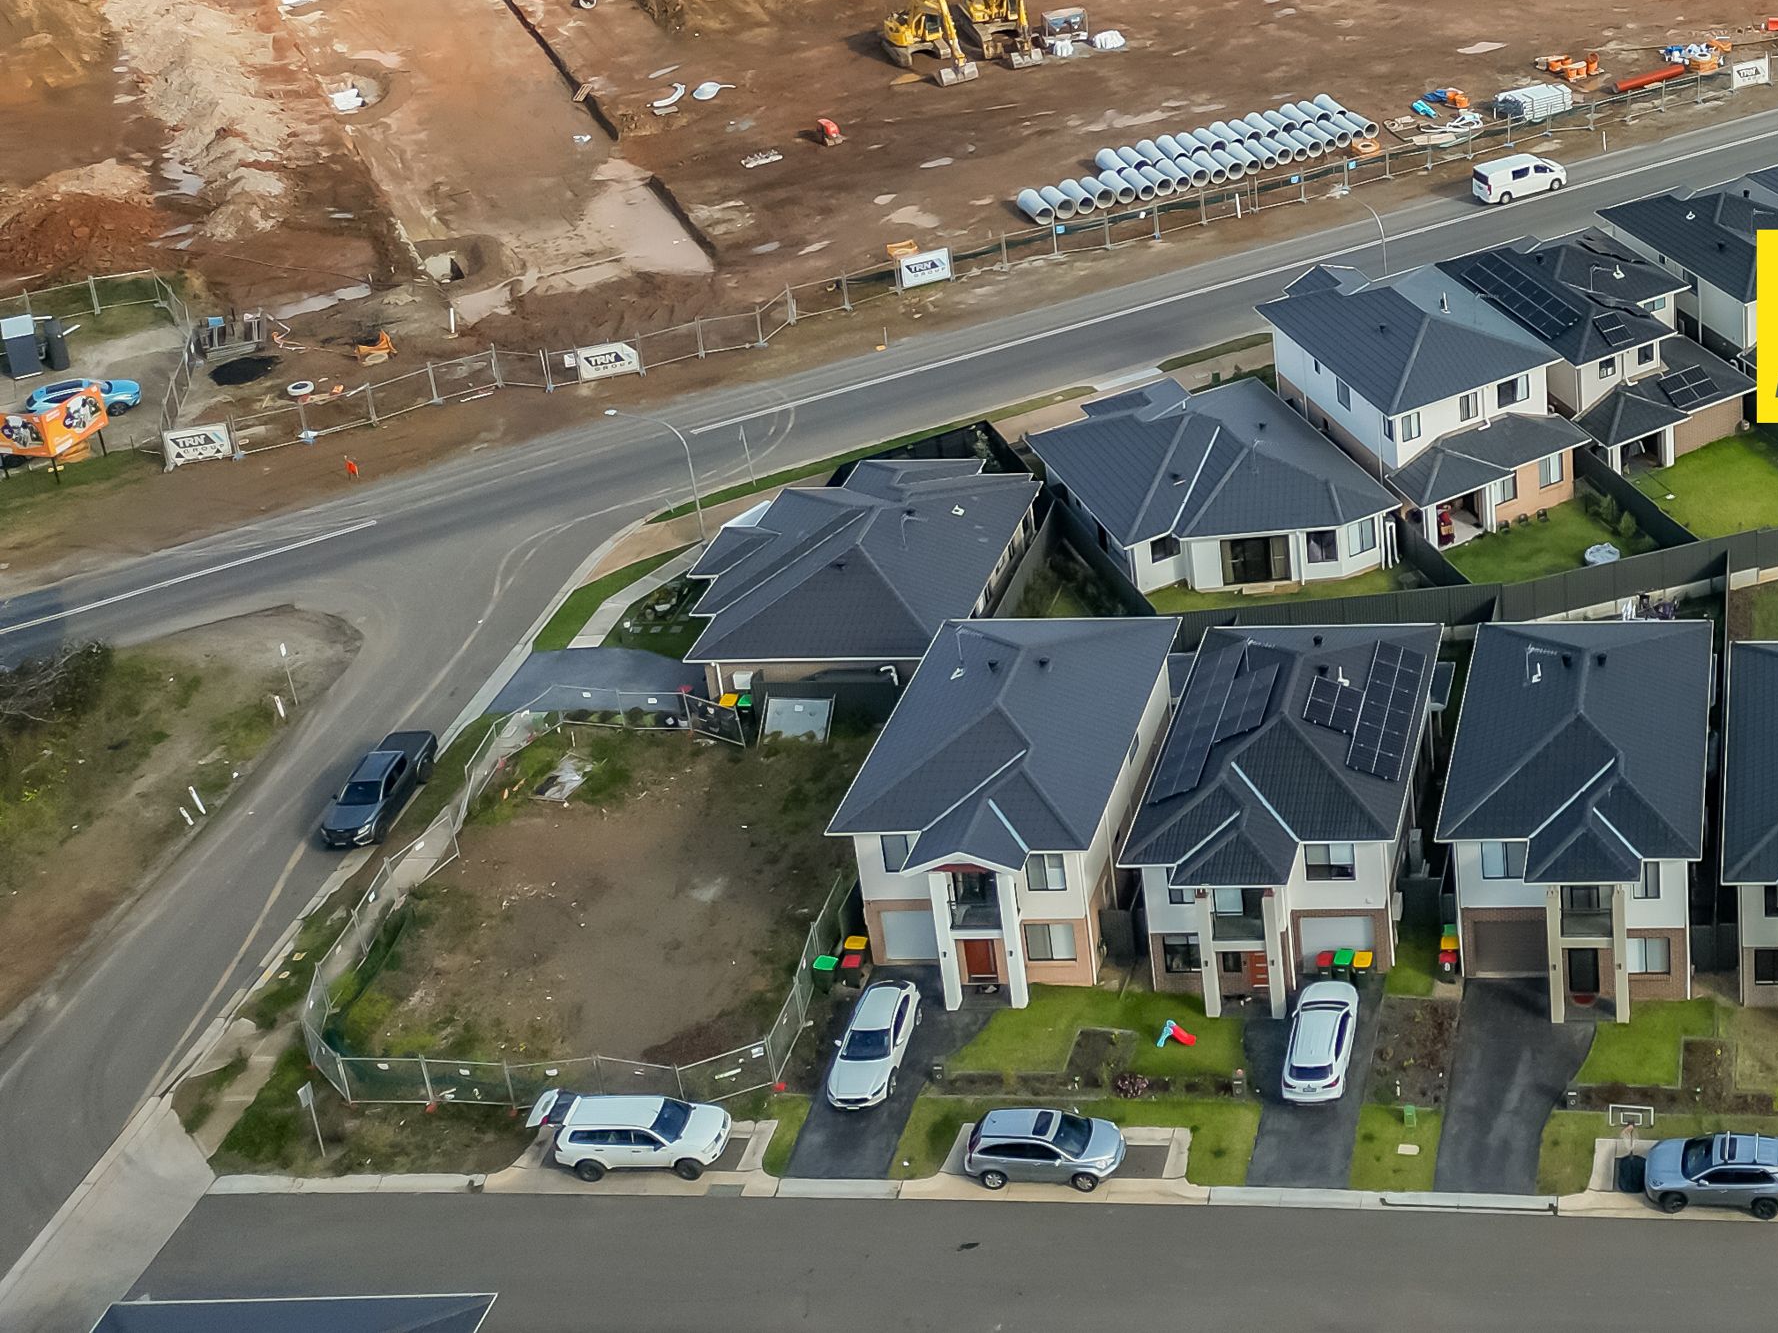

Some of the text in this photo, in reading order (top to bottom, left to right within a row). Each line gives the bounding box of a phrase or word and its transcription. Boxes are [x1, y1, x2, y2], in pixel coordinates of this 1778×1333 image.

[909, 260, 932, 272] TRN
[588, 353, 617, 366] TRN
[594, 361, 633, 372] GROUP
[175, 434, 206, 447] TRN
[182, 443, 225, 455] GROUP
